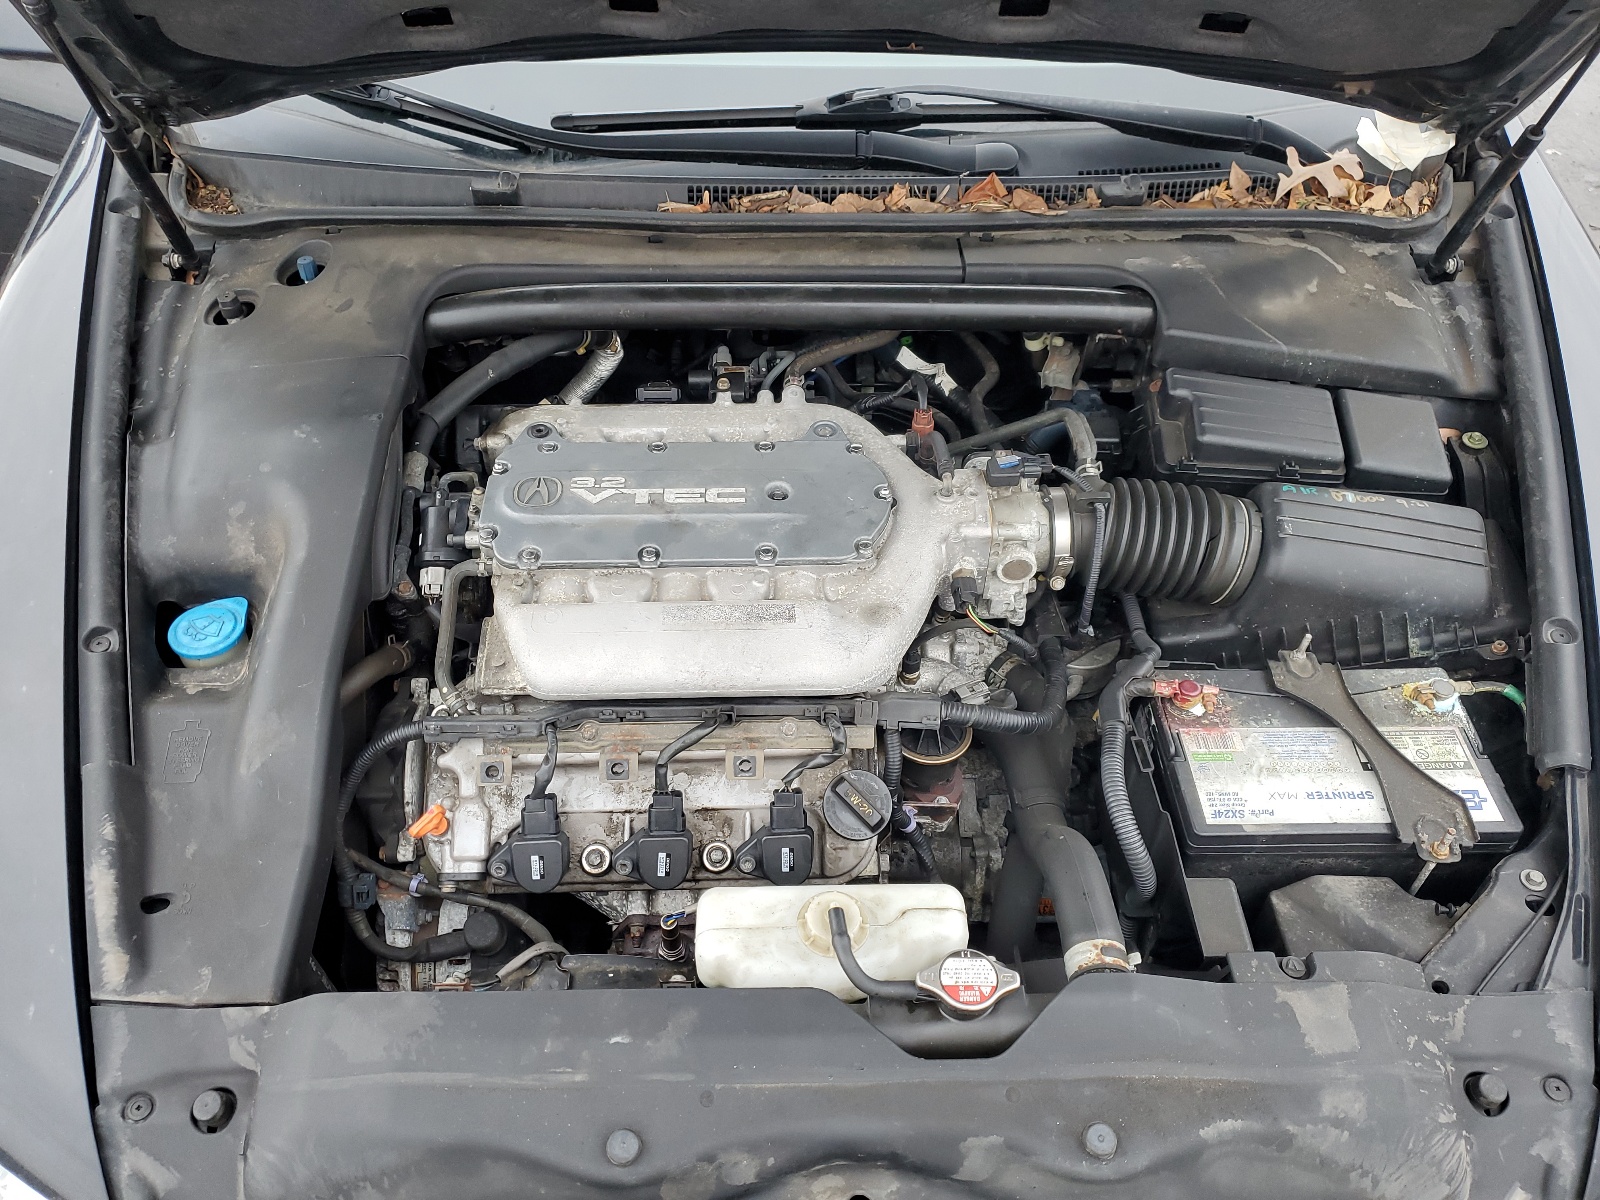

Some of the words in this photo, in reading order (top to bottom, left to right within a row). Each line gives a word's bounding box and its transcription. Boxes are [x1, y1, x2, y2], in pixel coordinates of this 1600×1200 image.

[569, 476, 626, 488] 3.2
[569, 487, 747, 505] VTEC
[1268, 793, 1298, 801] MAX
[1306, 791, 1374, 801] SPRINTER
[1210, 809, 1245, 818] SX24F
